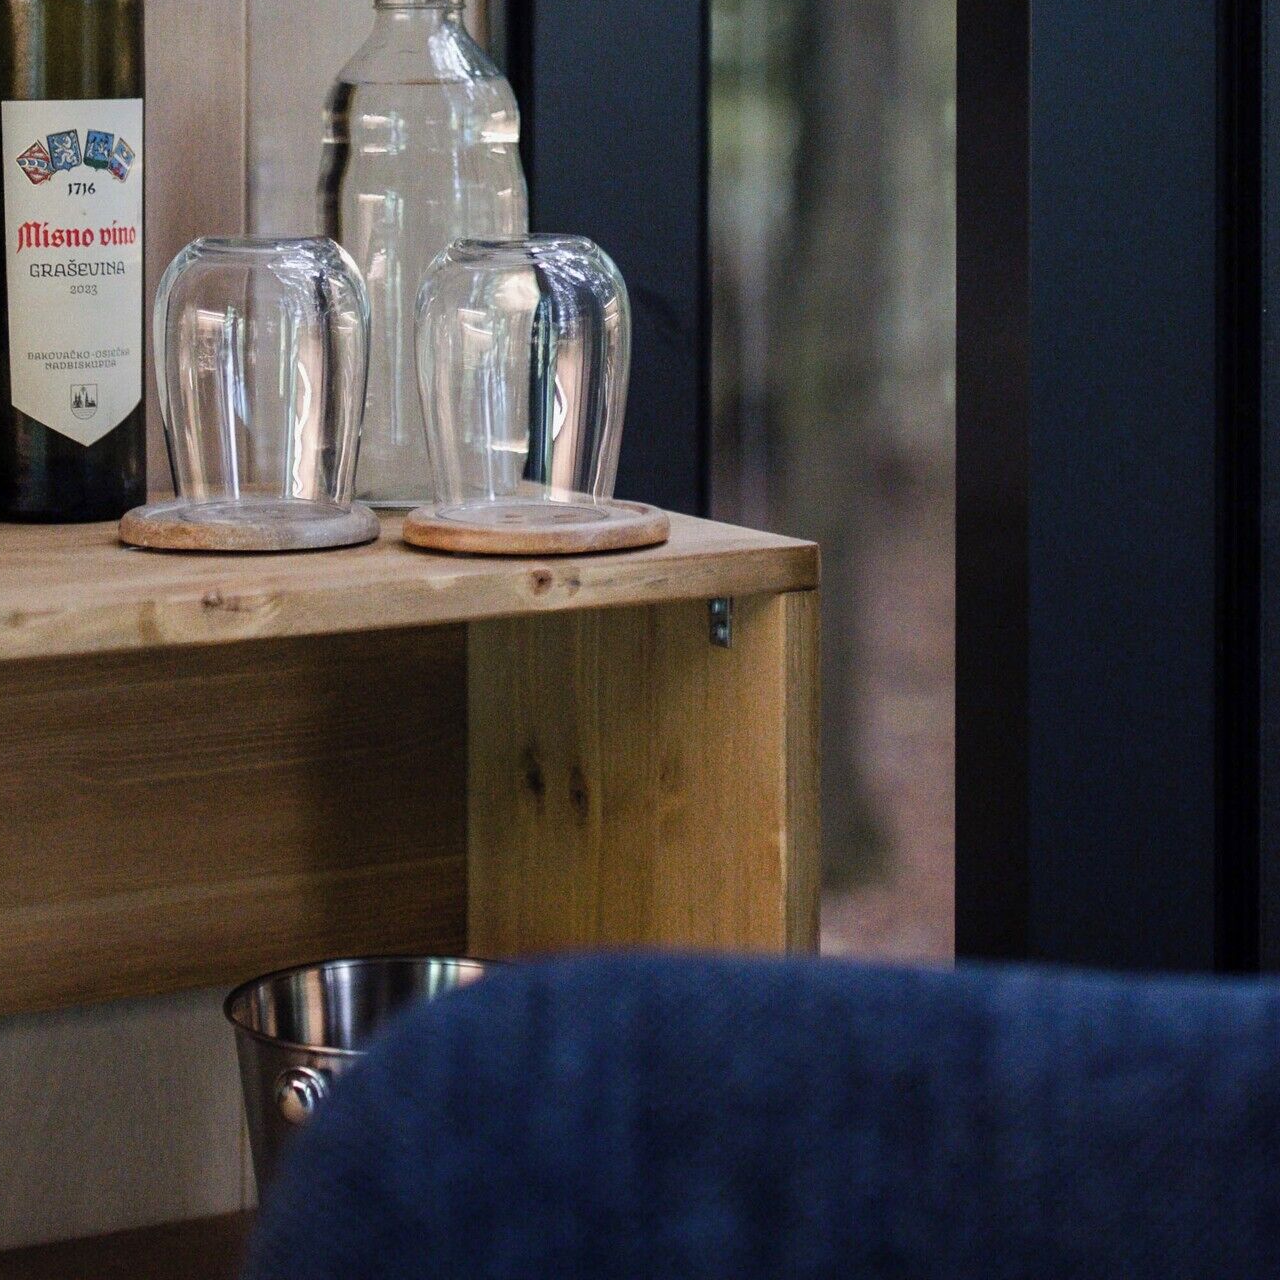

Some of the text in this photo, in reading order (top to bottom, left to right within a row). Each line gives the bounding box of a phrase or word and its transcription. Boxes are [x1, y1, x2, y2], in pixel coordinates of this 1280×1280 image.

[68, 182, 96, 196] 1716
[16, 220, 136, 255] Misno vino
[29, 259, 126, 278] GRAŠEVINA
[70, 284, 98, 296] 2023
